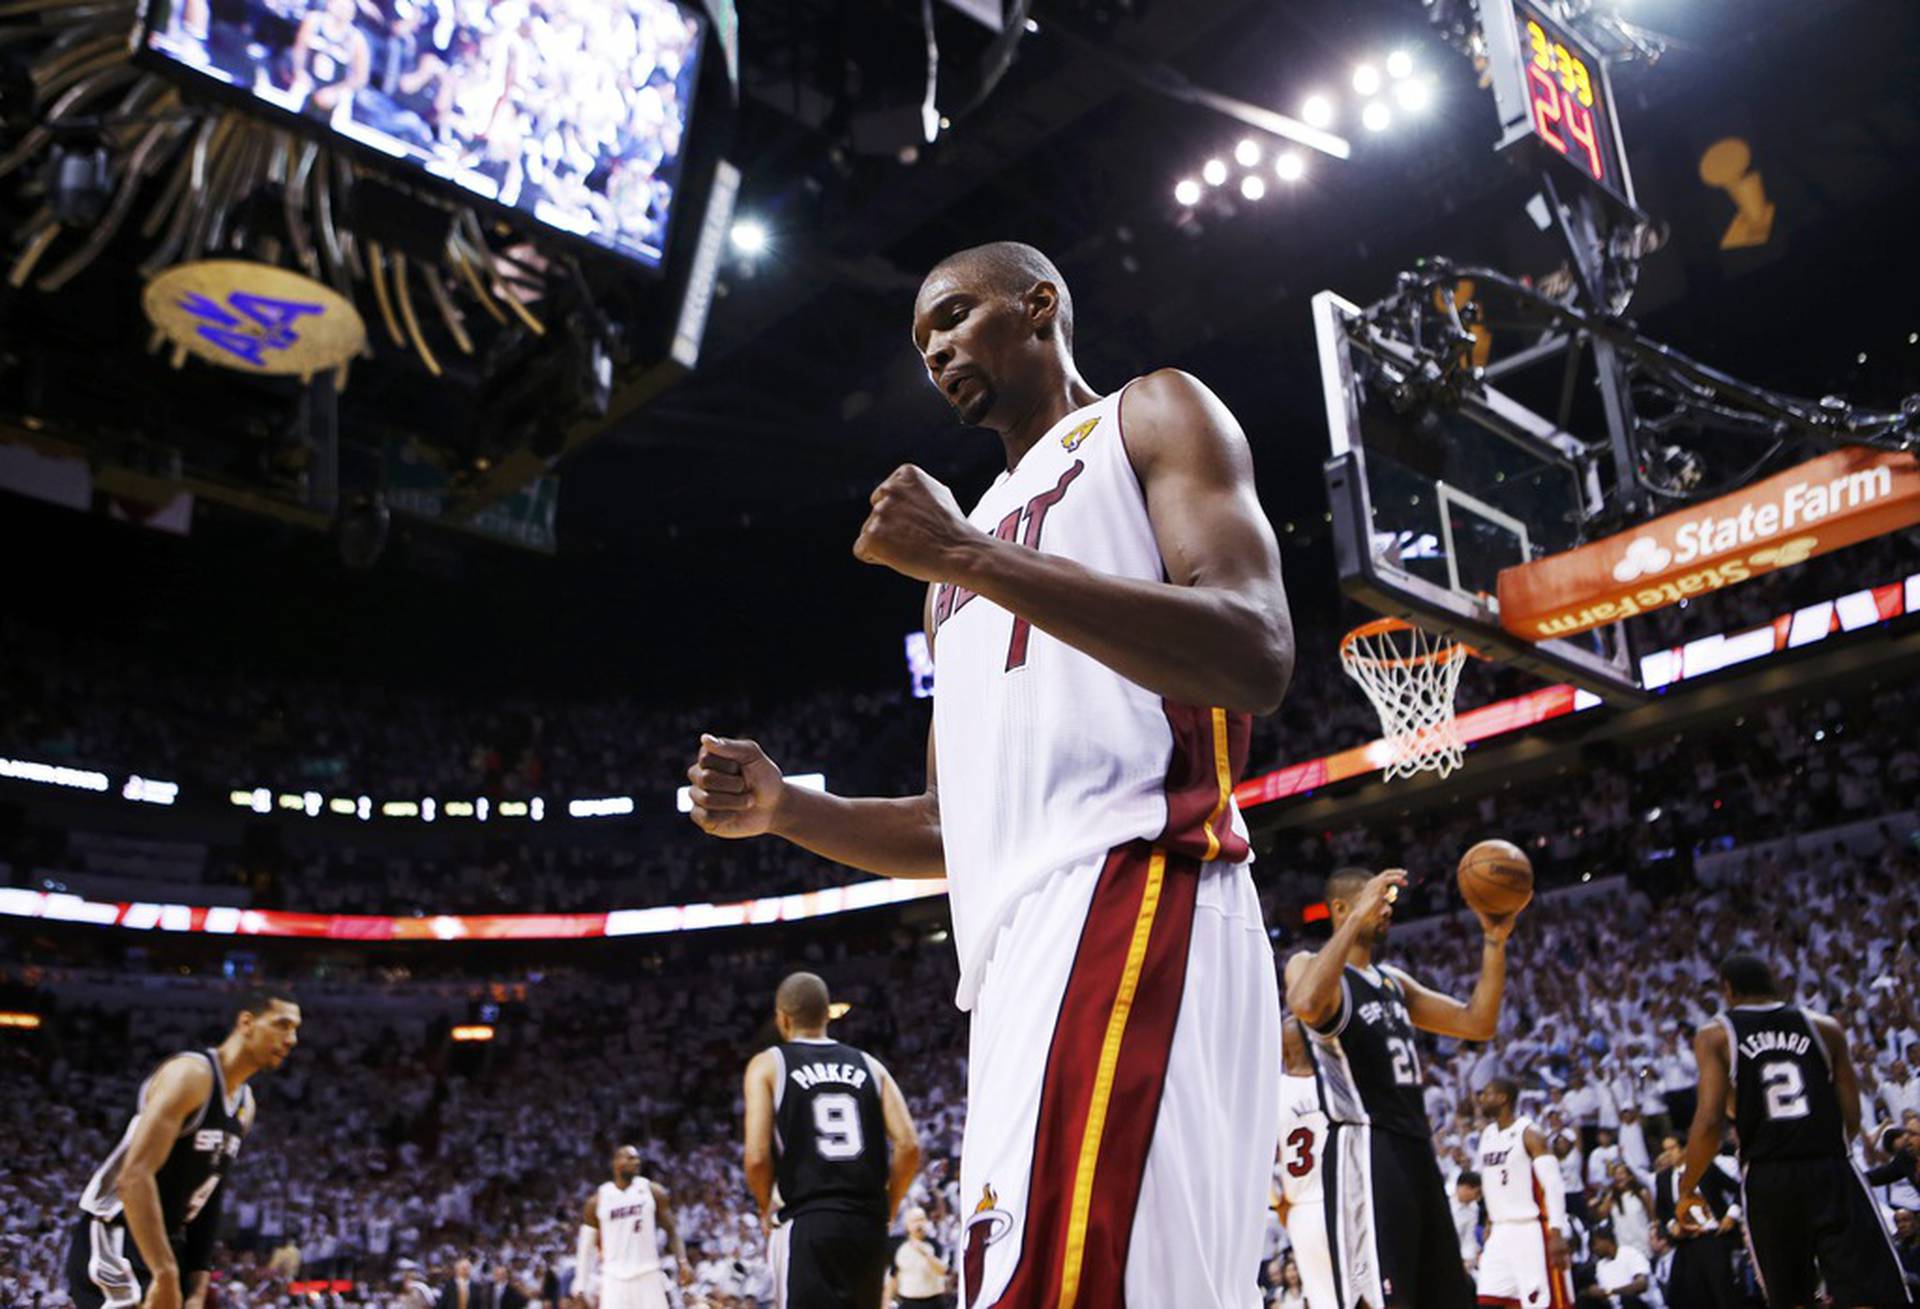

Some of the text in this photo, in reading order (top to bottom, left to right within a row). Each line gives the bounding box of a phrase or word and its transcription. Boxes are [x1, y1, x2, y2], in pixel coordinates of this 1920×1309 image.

[1527, 62, 1604, 182] 24
[1739, 1030, 1811, 1060] LEONARD
[790, 1062, 868, 1091] PARKER
[1761, 1061, 1811, 1119] 2
[812, 1091, 865, 1162] 9
[1275, 1126, 1315, 1178] 3
